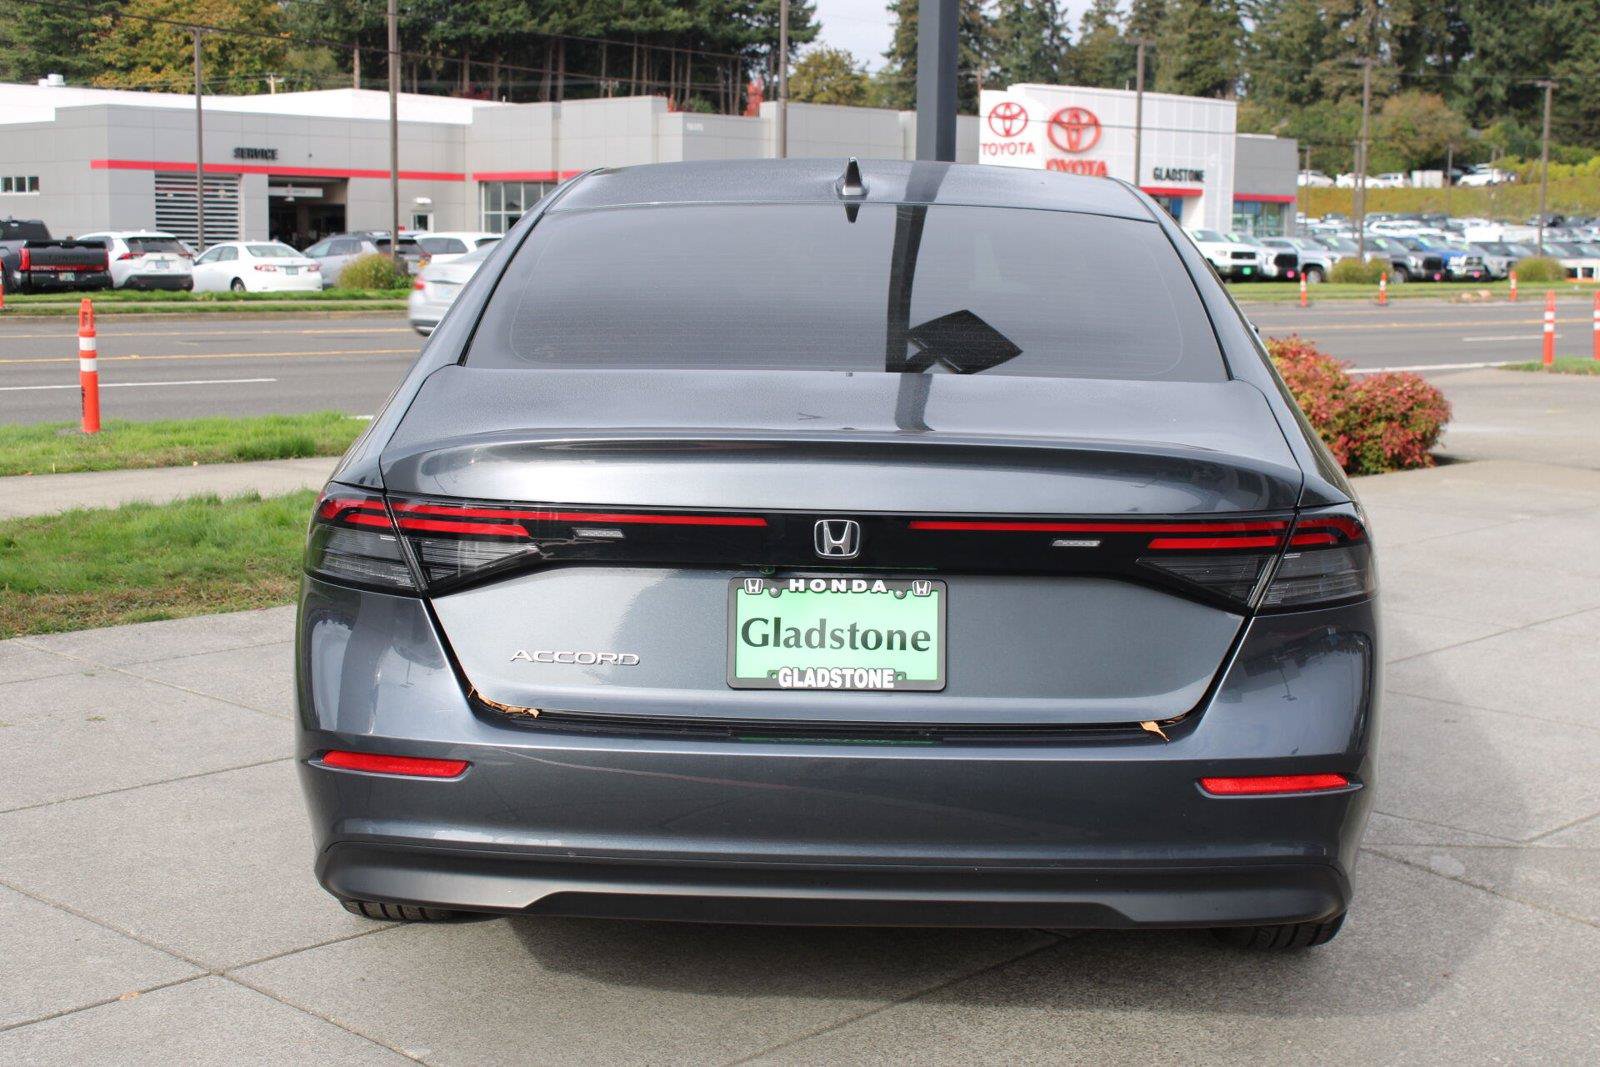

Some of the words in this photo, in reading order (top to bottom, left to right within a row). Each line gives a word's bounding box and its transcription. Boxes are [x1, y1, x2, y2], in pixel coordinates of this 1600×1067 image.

[234, 148, 278, 160] SERVICE
[980, 142, 1035, 156] TOYOTA
[1046, 159, 1108, 177] OYOTA
[1153, 167, 1204, 182] GLADSTONE
[789, 578, 887, 593] HONDA
[741, 617, 931, 652] Gladstone
[509, 649, 640, 667] ACCORD
[778, 667, 895, 689] GLADSTONE
